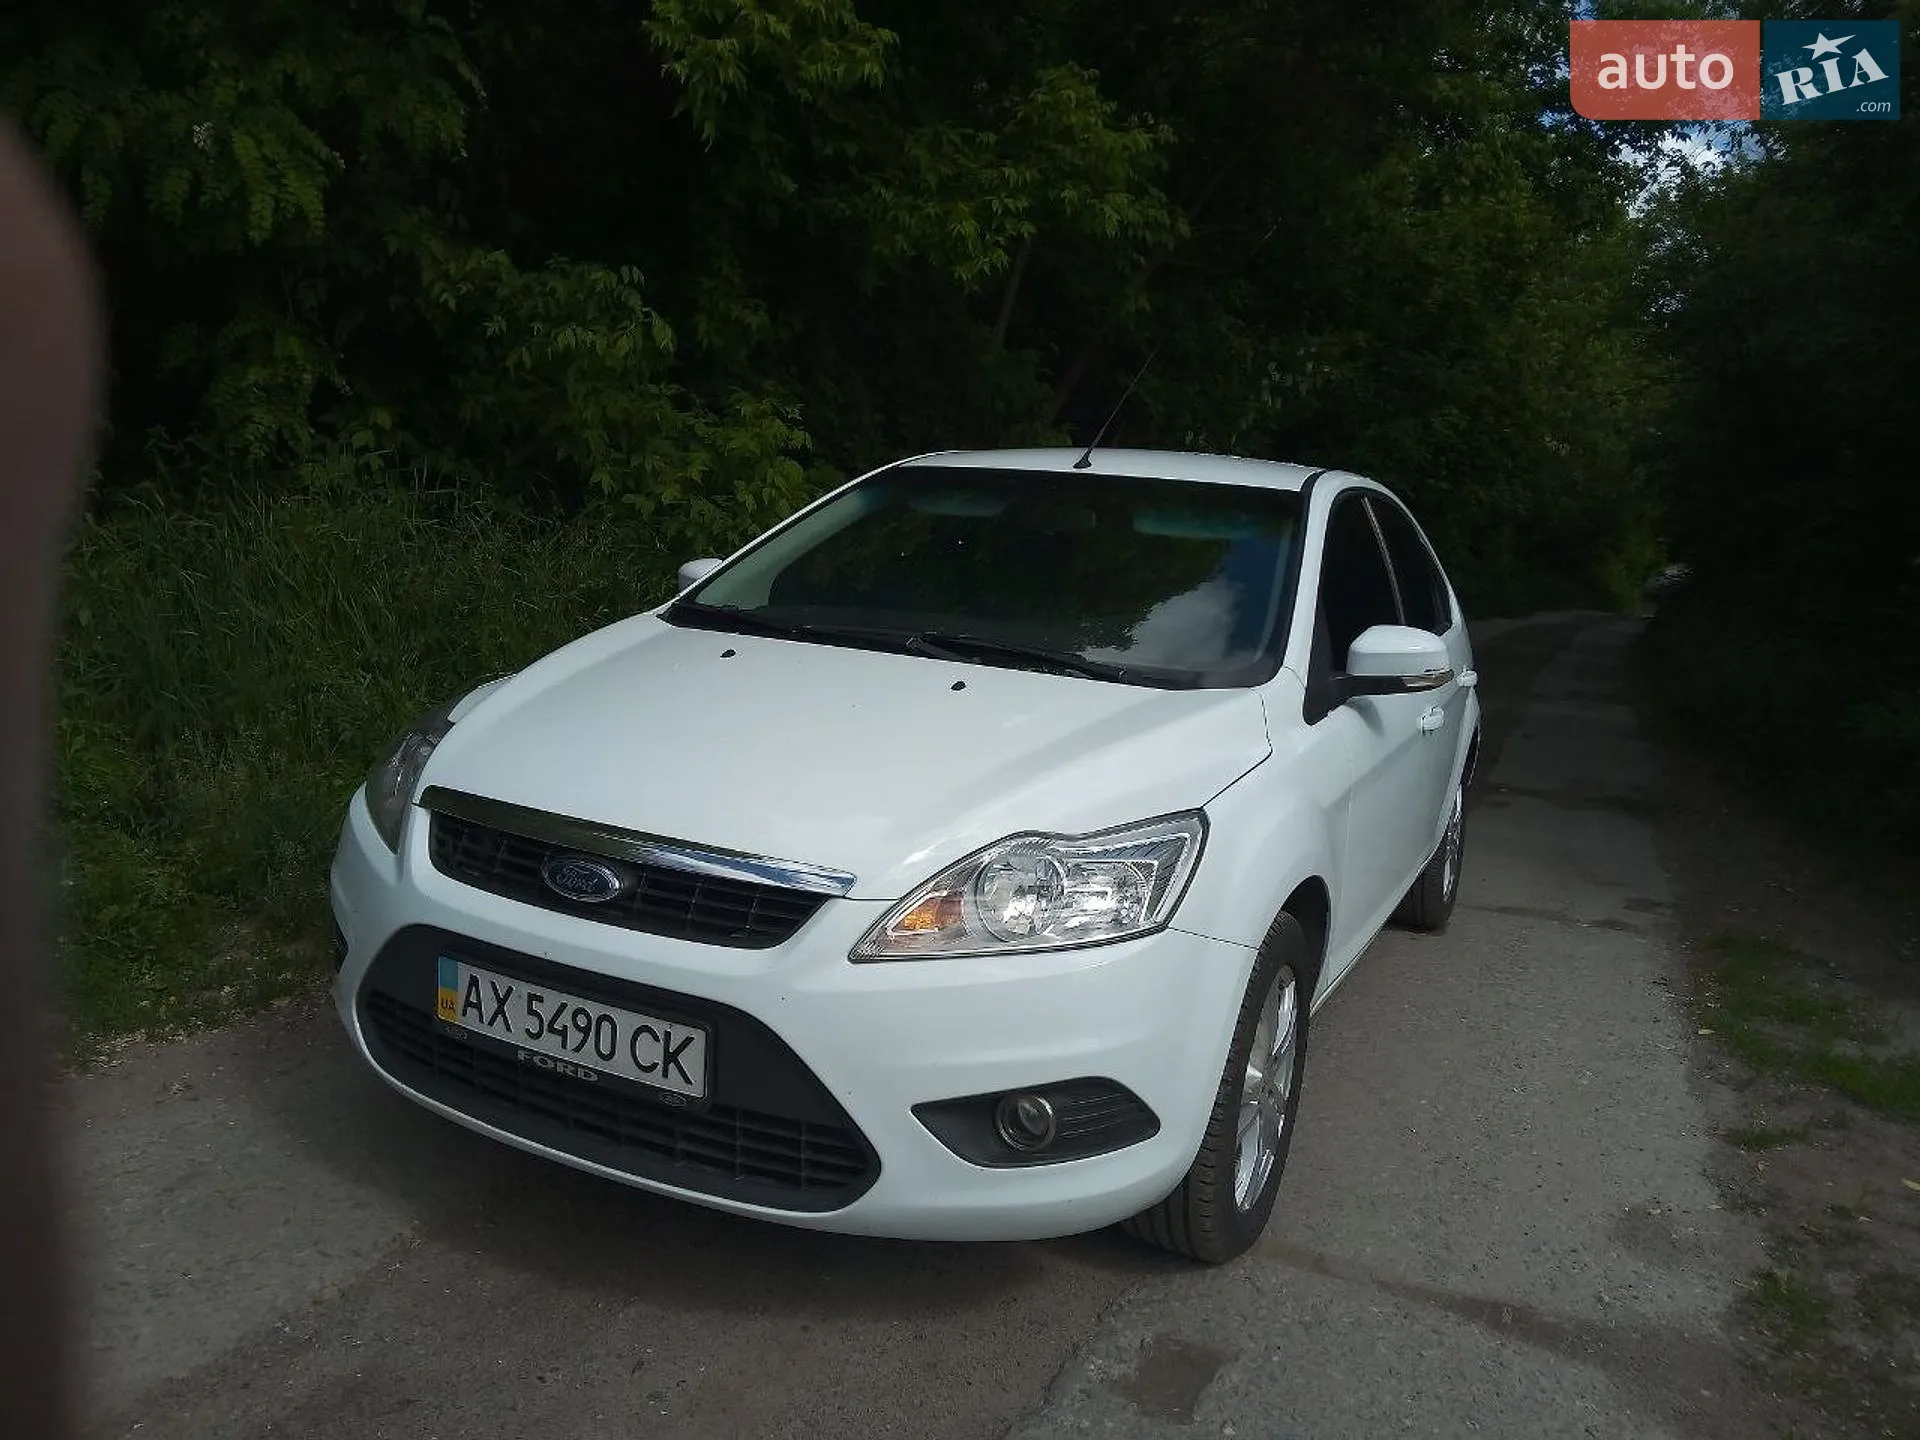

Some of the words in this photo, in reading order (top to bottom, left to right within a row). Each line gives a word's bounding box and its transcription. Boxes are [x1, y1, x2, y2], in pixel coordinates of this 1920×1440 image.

[462, 973, 514, 1034] AX
[524, 992, 618, 1062] 5490
[629, 1024, 695, 1086] CK
[517, 1051, 599, 1081] FORD
